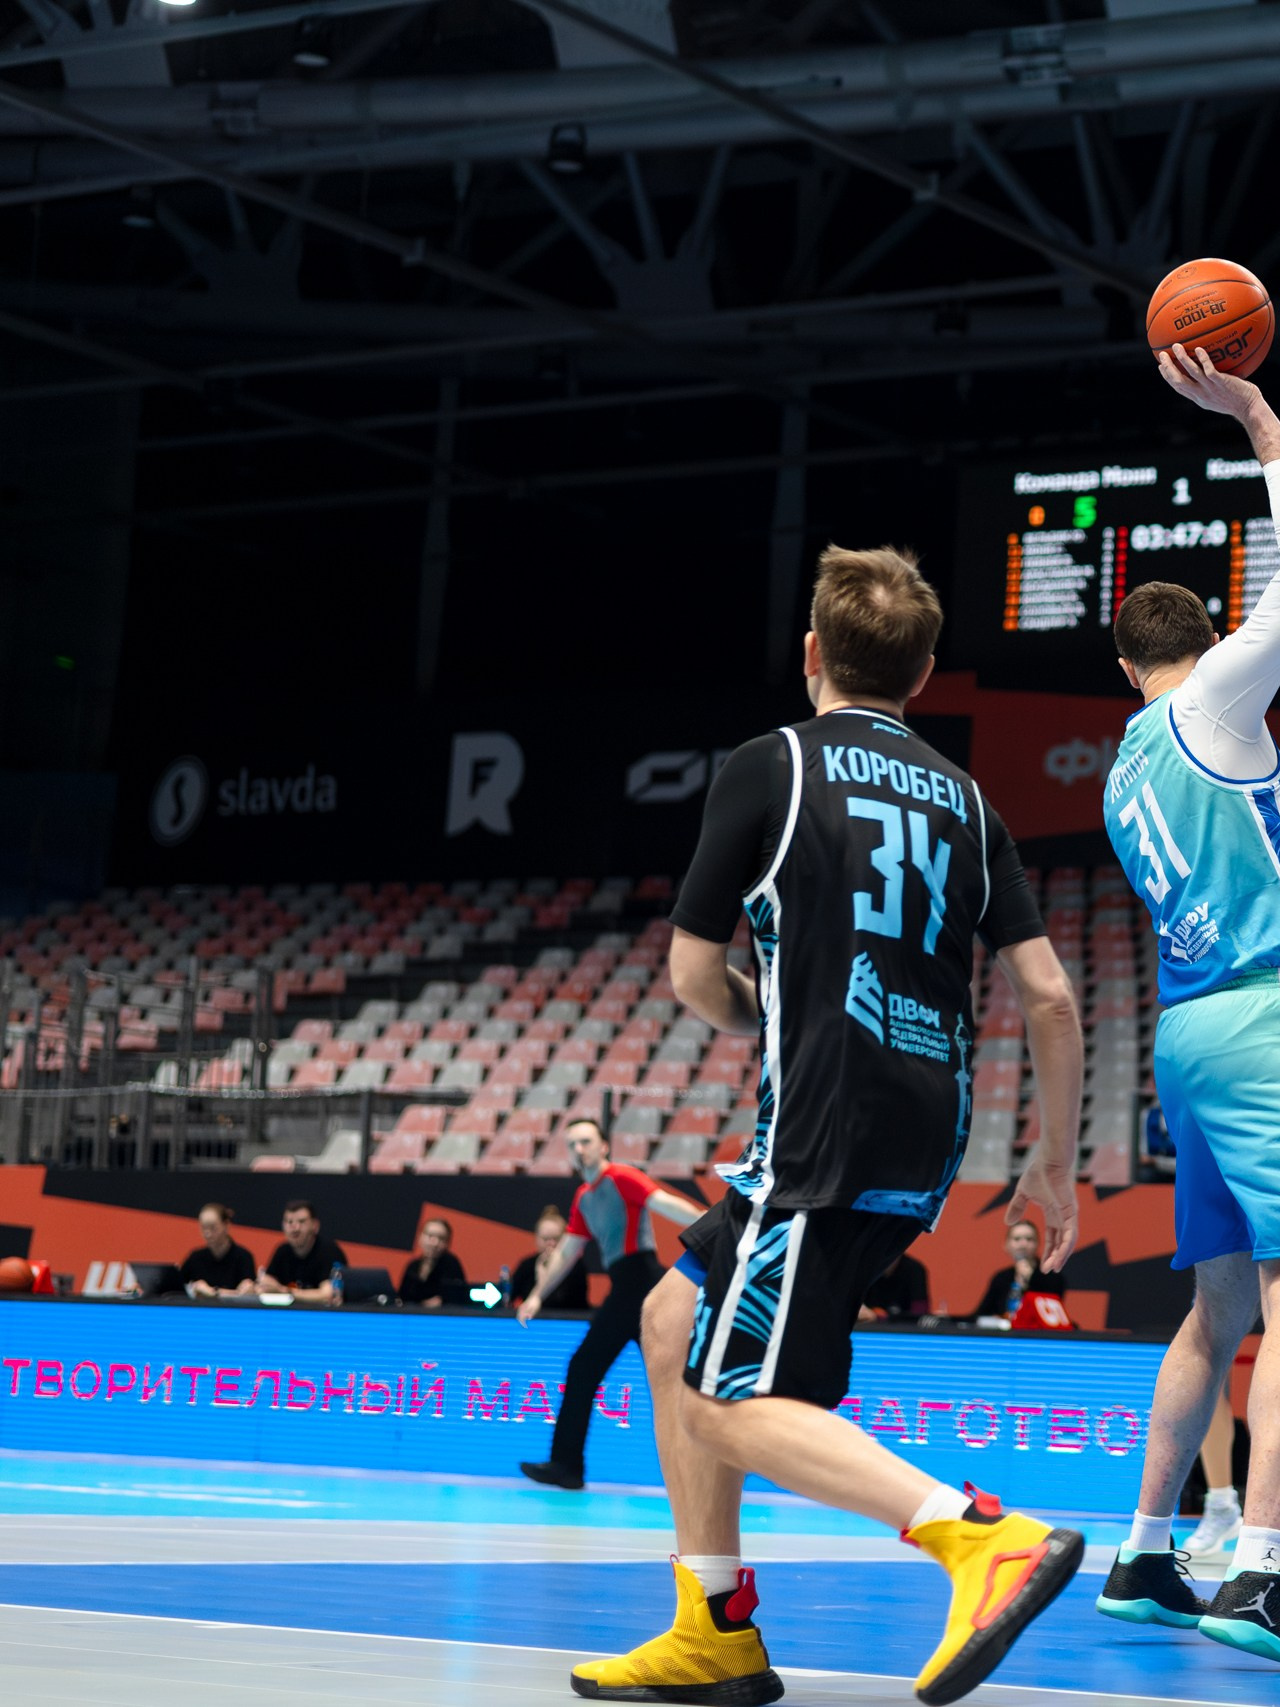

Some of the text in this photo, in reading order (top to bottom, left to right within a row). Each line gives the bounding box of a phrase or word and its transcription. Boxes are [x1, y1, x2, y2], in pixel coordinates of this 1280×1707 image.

[1174, 302, 1226, 331] JB-1000
[1208, 326, 1253, 364] JÖG
[1172, 477, 1192, 506] 1
[1207, 457, 1264, 480] Коман
[1073, 495, 1098, 529] 5
[217, 763, 338, 817] slavda
[822, 744, 969, 825] КОРОБЕЦ
[1118, 780, 1192, 905] 31
[2, 1357, 633, 1428] ТВОРИТЕЛЬНЫЙ МАЧ
[831, 1395, 1152, 1457] ЛАГОТВО
